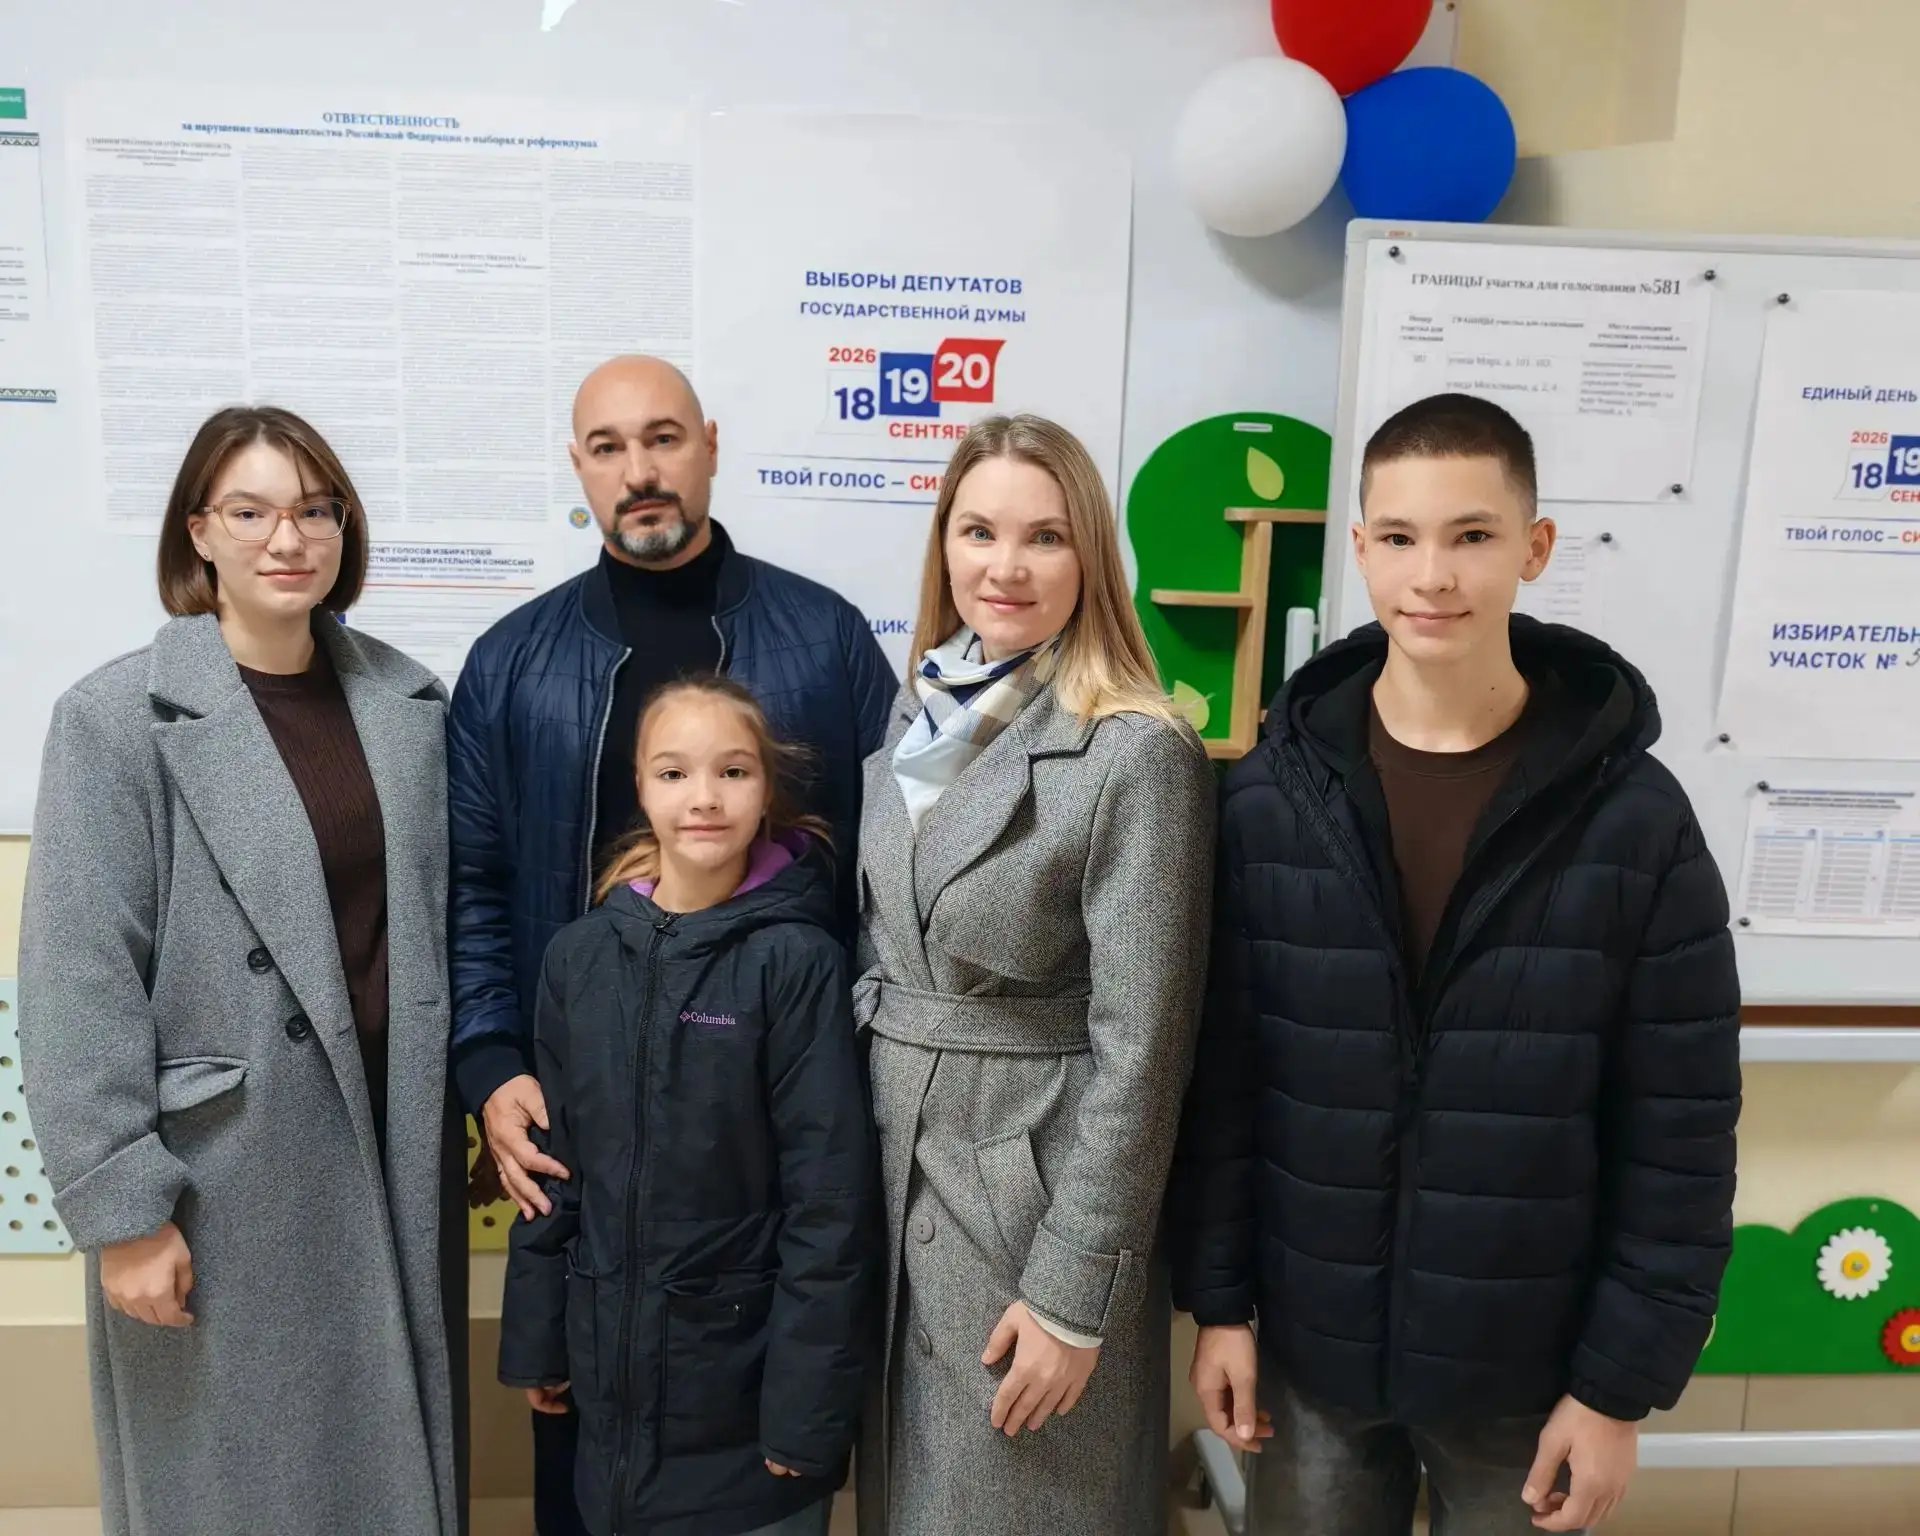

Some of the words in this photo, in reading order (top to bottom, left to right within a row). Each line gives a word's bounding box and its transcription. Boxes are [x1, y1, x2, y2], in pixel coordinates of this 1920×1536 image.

[322, 112, 460, 129] ОТВЕТСТВЕННОСТЬ
[805, 271, 896, 290] ВЫБОРЫ
[902, 274, 1022, 294] ДЕПУТАТОВ
[1411, 272, 1486, 289] ГРАНИЦЫ
[1486, 277, 1534, 291] участка
[1536, 280, 1559, 291] для
[1561, 280, 1637, 294] голосования
[800, 301, 970, 321] ГОСУДАРСТВЕННОЙ
[974, 308, 1026, 323] ДУМЫ
[829, 347, 876, 364] 2026
[834, 386, 876, 421] 18
[885, 367, 929, 405] 19
[937, 352, 990, 390] 20
[1802, 386, 1872, 401] ЕДИНЫЙ
[1875, 388, 1918, 403] ДЕНЬ
[889, 422, 968, 441] СЕНТЯБ
[1851, 431, 1888, 444] 2026
[1851, 462, 1883, 489] 18
[1893, 446, 1920, 477] 19
[758, 467, 813, 486] ТВОЙ
[819, 470, 886, 489] ГОЛОС
[910, 474, 945, 491] СИ
[1890, 489, 1920, 503] СЕН
[1785, 526, 1828, 541] ТВОЙ
[1832, 528, 1884, 543] ГОЛОС
[1772, 623, 1920, 643] ИЗБИРАТЕЛЬН
[1769, 650, 1866, 669] УЧАСТОК
[1876, 652, 1898, 669] №
[690, 1011, 736, 1025] Columbia
